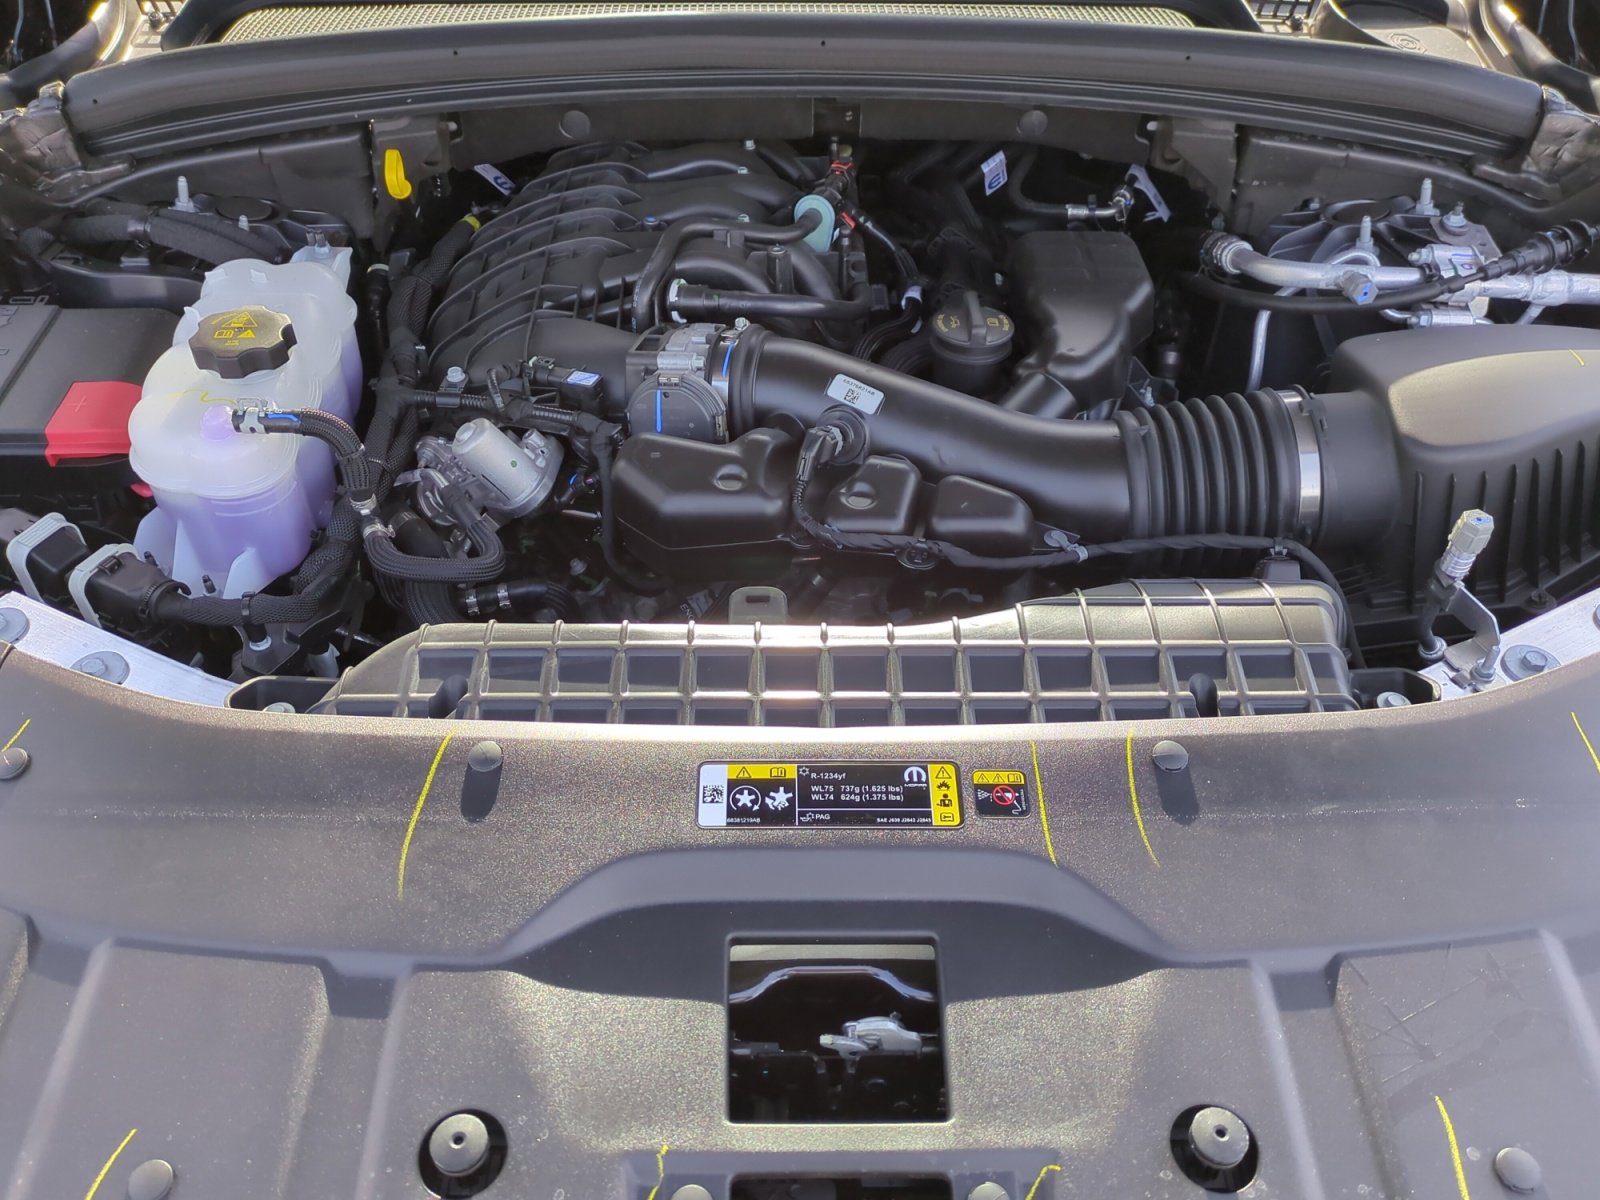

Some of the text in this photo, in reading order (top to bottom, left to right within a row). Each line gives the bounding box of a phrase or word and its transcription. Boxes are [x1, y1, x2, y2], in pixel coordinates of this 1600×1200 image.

[810, 772, 846, 780] R-1234yf
[840, 785, 860, 793] 737g
[861, 785, 886, 793] (1.625
[888, 785, 904, 793] lbs)
[840, 794, 860, 802] 624g
[862, 794, 887, 802] (1.375
[888, 794, 904, 802] lbs)
